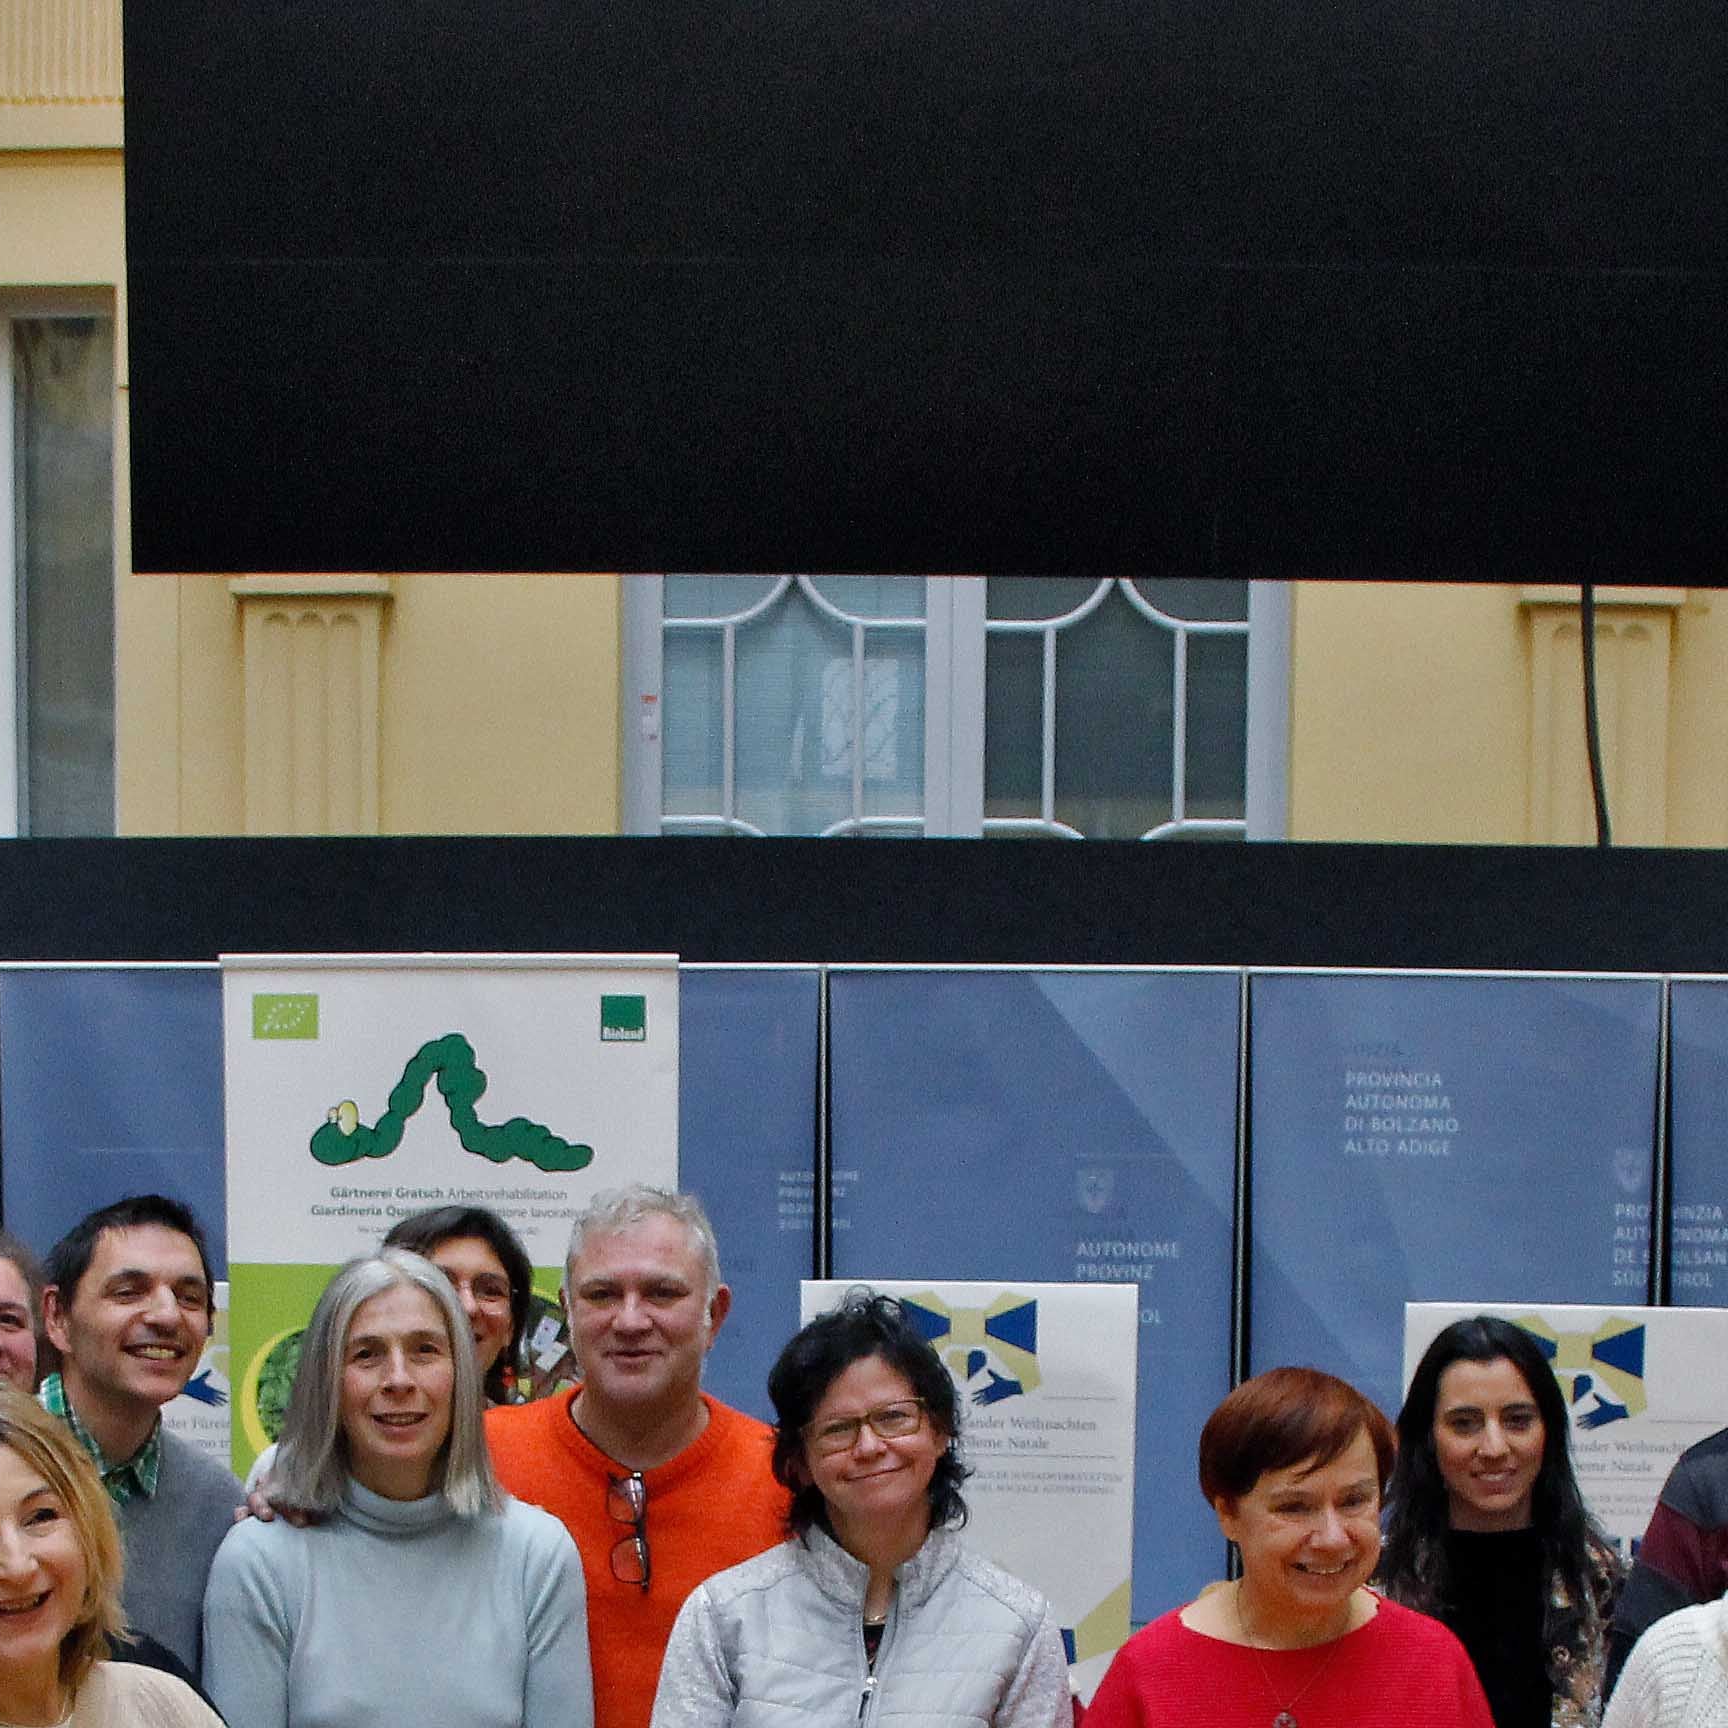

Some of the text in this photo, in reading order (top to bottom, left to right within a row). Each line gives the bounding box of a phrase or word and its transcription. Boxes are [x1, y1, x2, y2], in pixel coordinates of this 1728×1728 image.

[1345, 1071, 1441, 1087] PROVINCIA
[1345, 1094, 1451, 1110] AUTONOMA
[1345, 1116, 1459, 1133] DI BOLZANO
[1344, 1139, 1450, 1155] ALTO ADIGE
[330, 1186, 393, 1199] Gärtnerei
[396, 1186, 444, 1199] Gratsch
[311, 1204, 382, 1217] Giardineria
[1076, 1241, 1180, 1257] AUTONOME
[1076, 1263, 1155, 1280] PROVINZ
[1010, 1417, 1097, 1432] Weihnachten
[1008, 1437, 1051, 1450] Natale
